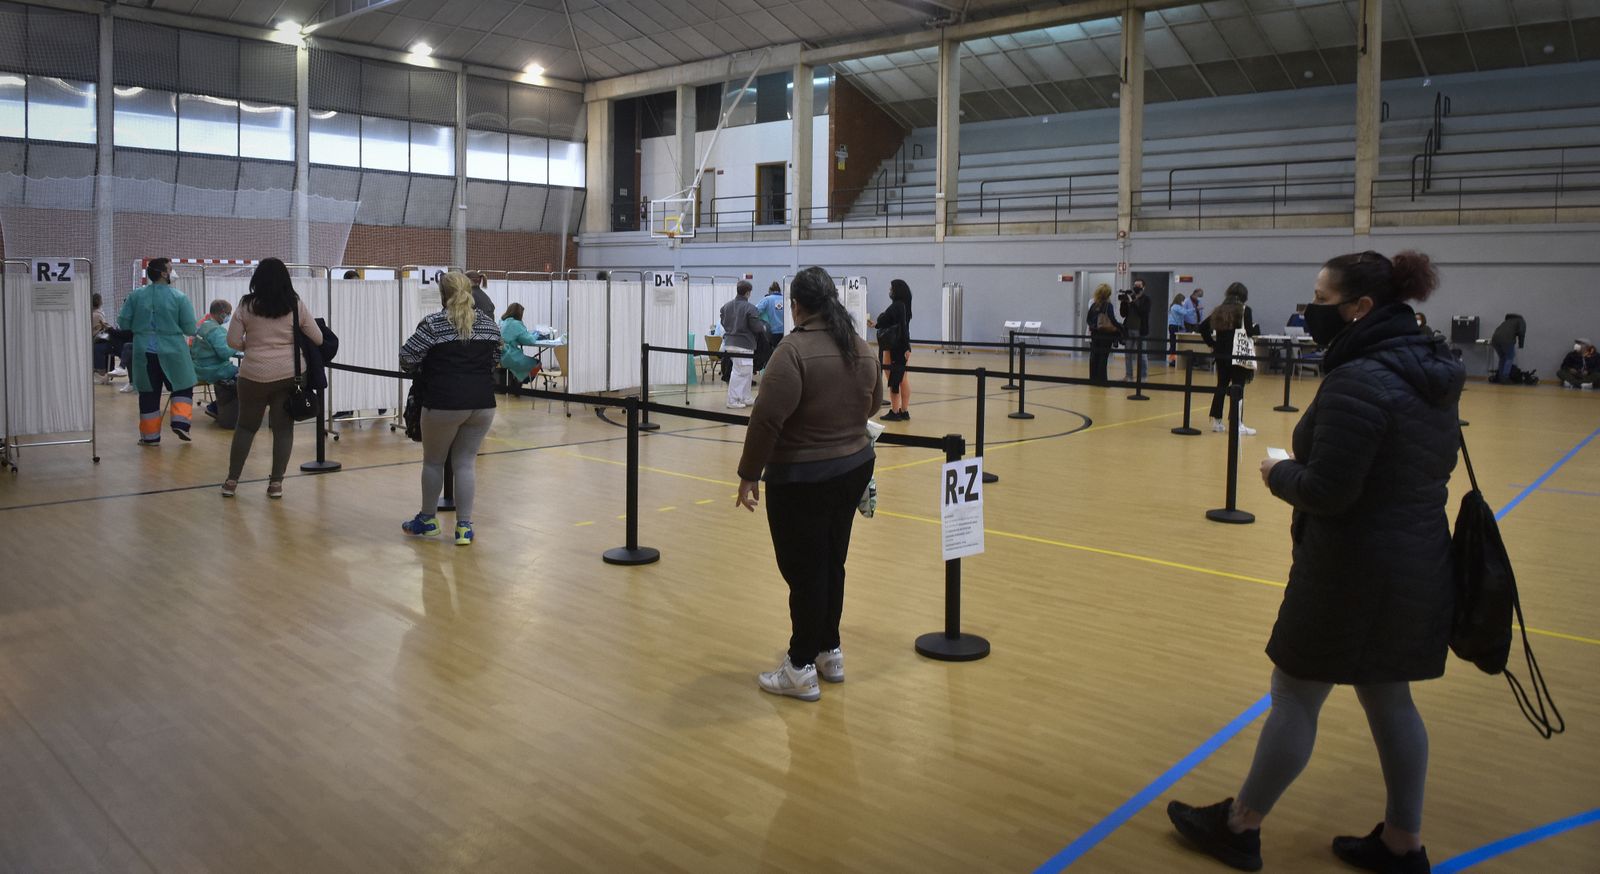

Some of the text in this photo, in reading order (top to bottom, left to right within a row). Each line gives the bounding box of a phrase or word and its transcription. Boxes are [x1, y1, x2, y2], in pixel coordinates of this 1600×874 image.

[37, 262, 71, 282] R-Z
[654, 274, 674, 287] D-K
[848, 279, 859, 290] A-C
[945, 464, 979, 505] R-Z
